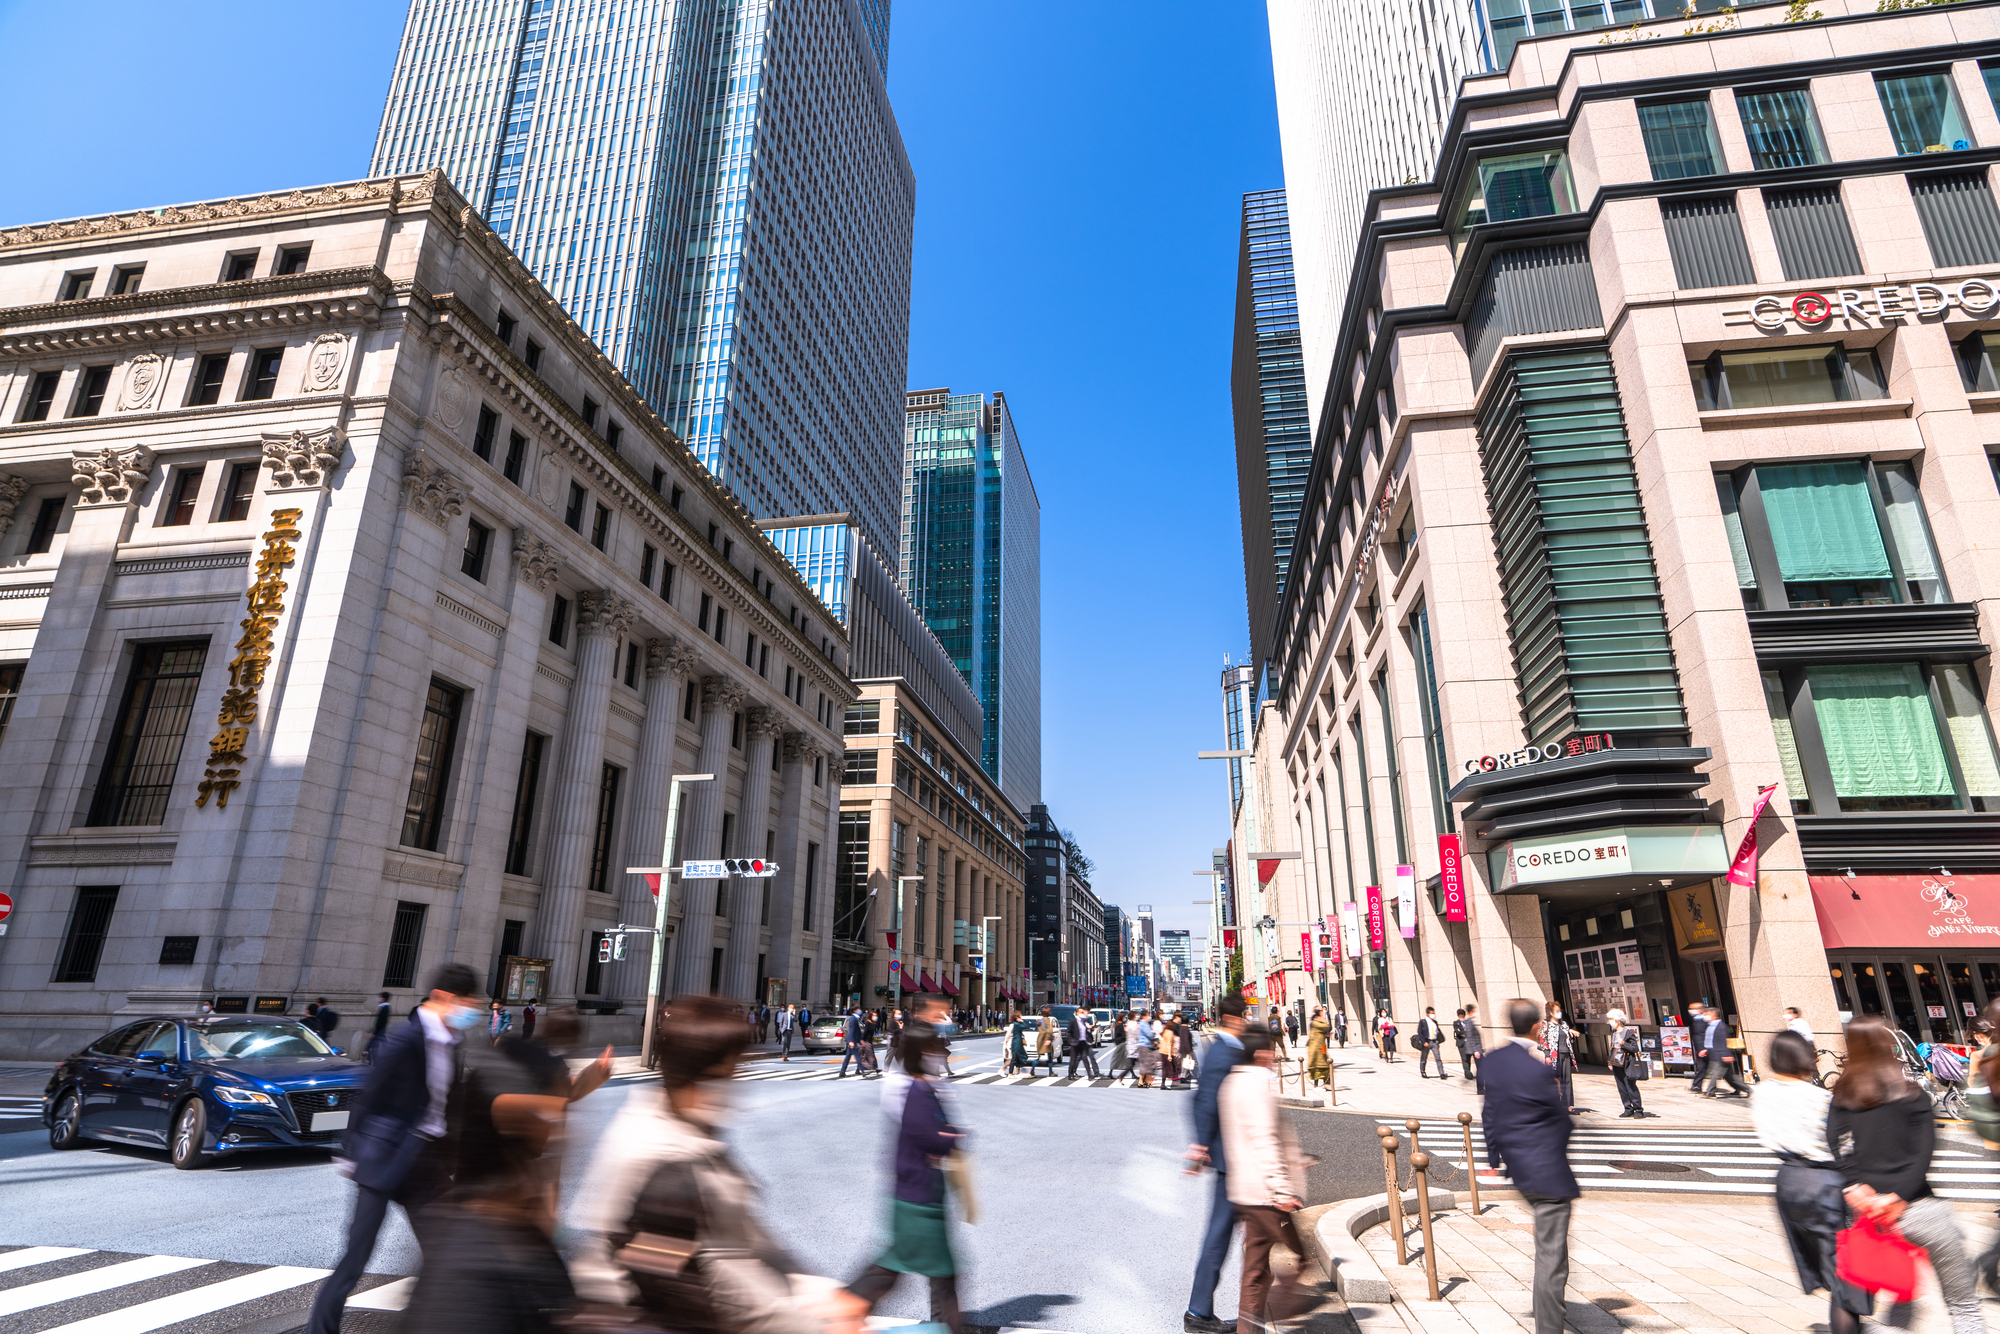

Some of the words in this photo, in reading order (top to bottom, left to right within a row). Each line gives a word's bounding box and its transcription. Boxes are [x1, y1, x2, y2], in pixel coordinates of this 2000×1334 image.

[1750, 278, 2000, 326] COREDO
[195, 508, 303, 807] 三井住友信託銀行
[1464, 742, 1562, 775] COREDO
[1565, 733, 1613, 757] 室町1
[685, 864, 722, 872] 室町二丁目
[1444, 848, 1459, 902] COREDO
[1517, 848, 1591, 868] COREDO
[1594, 845, 1627, 861] 室町1
[1370, 896, 1381, 936] COREDO
[1303, 938, 1311, 964] COREDO
[1330, 921, 1339, 952] COREDO
